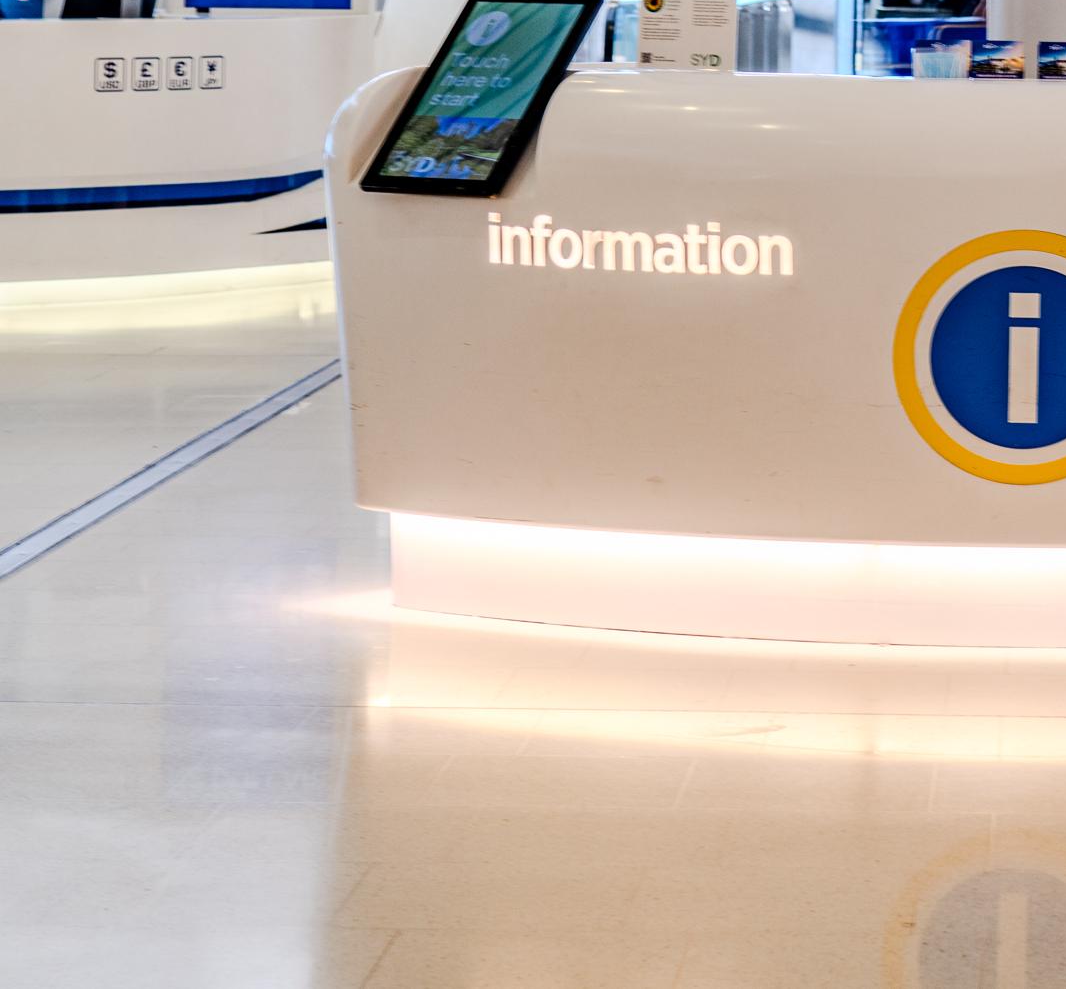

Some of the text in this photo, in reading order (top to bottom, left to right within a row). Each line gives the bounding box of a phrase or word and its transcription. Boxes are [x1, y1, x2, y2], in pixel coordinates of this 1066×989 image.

[453, 52, 510, 69] Touch
[690, 54, 721, 67] SYD
[440, 71, 512, 88] here to
[429, 91, 480, 107] start
[488, 212, 794, 275] information
